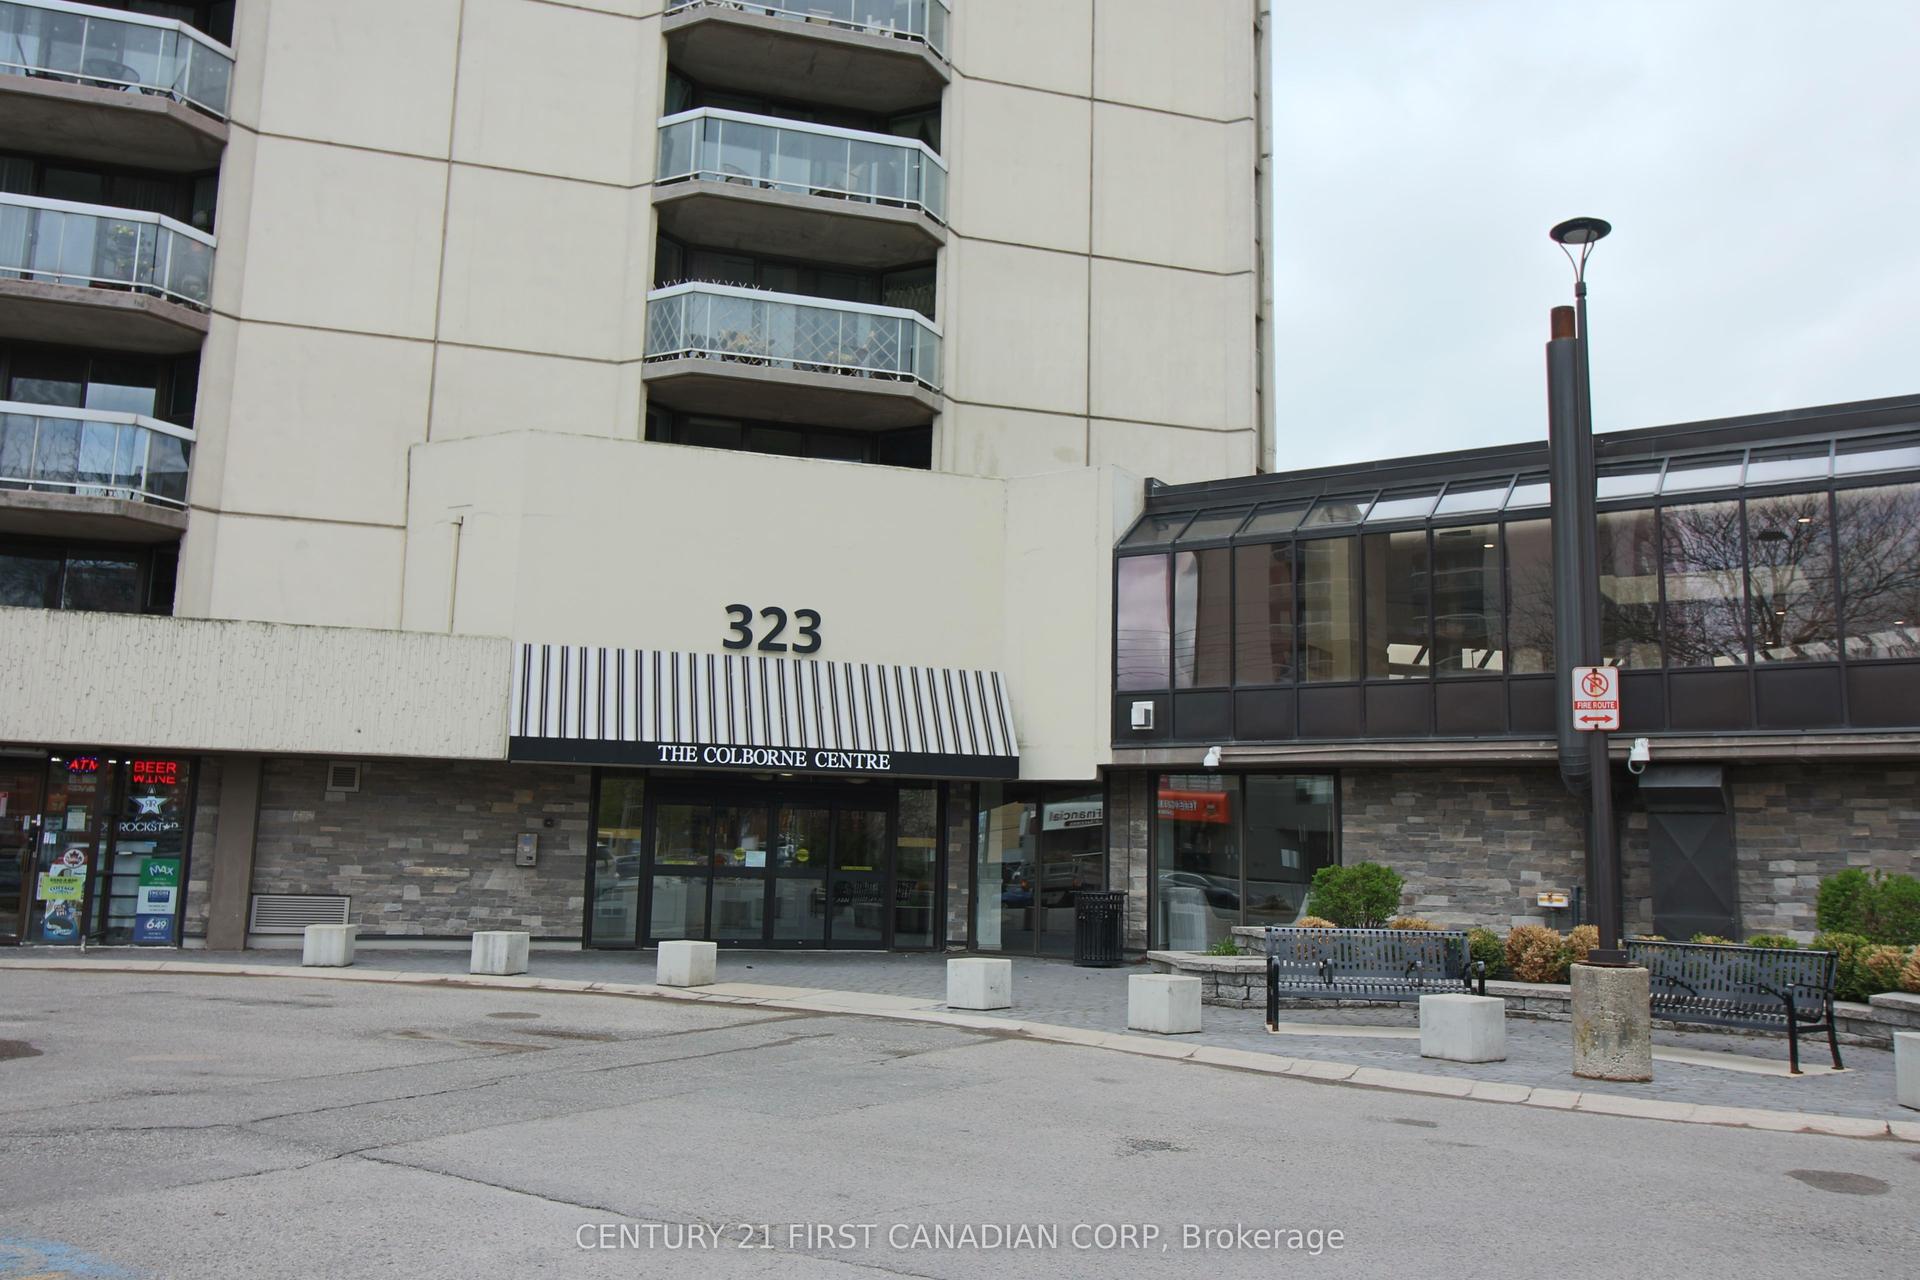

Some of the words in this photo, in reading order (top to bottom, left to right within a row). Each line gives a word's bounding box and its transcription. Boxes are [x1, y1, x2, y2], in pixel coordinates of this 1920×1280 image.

[723, 603, 822, 654] 323
[134, 761, 176, 773] BEER
[658, 744, 699, 764] THE
[703, 747, 807, 768] COLBORNE
[814, 750, 891, 771] CENTRE
[149, 865, 174, 876] MAX
